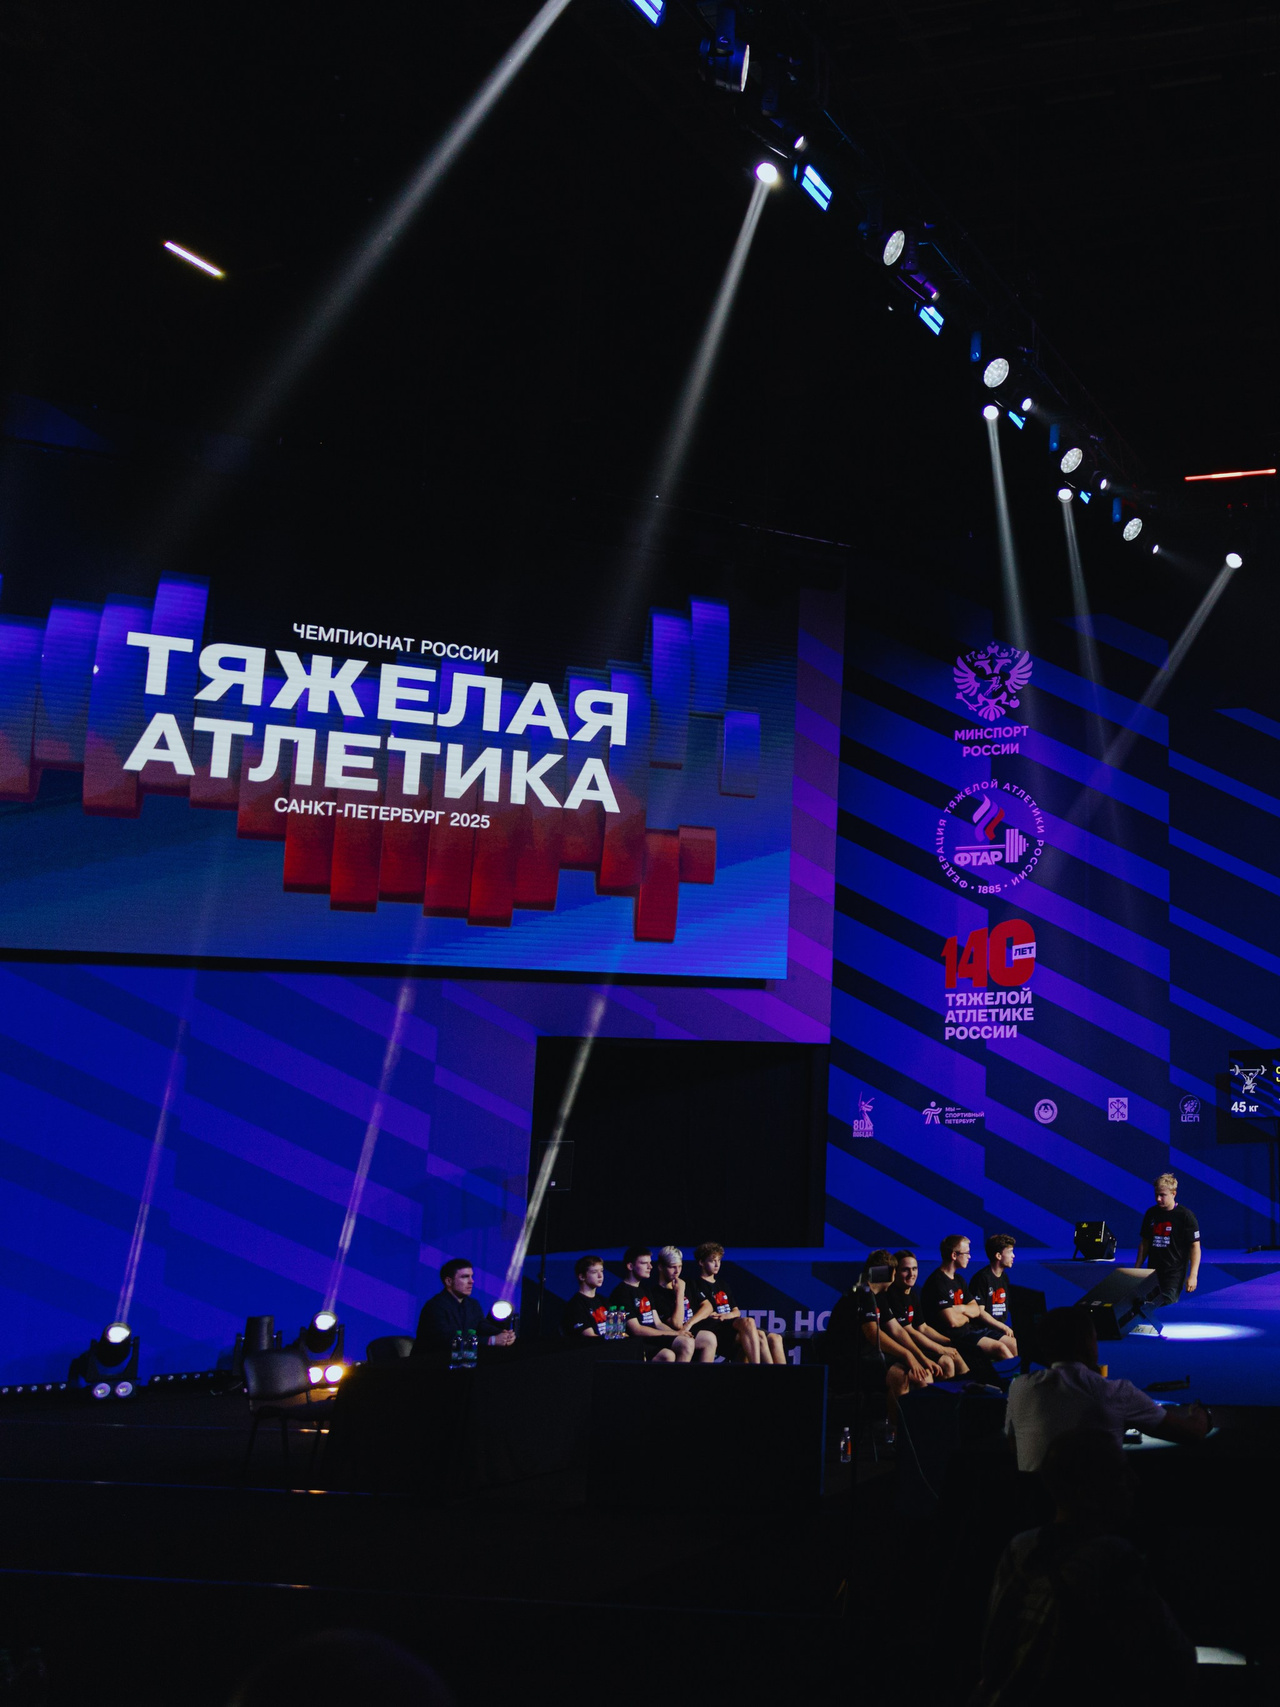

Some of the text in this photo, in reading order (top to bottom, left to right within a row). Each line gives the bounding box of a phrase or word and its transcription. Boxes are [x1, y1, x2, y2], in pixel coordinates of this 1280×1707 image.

[292, 622, 499, 664] ЧЕМПИОНАТ РОССИИ
[125, 631, 629, 747] ТЯЖЕЛАЯ
[954, 725, 1029, 741] МИНСПОРТ
[962, 743, 1020, 757] РОССИИ
[122, 712, 621, 813] АТЛЕТИКА
[273, 797, 491, 829] САНКТ-ПЕТЕРБУРГ 2025
[935, 779, 1045, 889] ФЕДЕРАЦИЯ ТЯЖЕЛОЙ АТЛЕТИКИ РОССИИ
[953, 850, 1004, 867] ФТАР
[977, 884, 1002, 895] 1885
[941, 918, 1035, 989] 140
[1013, 946, 1034, 957] ЛЕТ
[944, 987, 1033, 1007] ТЯЖЕЛОЙ
[944, 1007, 1035, 1023] АТЛЕТИКЕ
[944, 1024, 1018, 1040] РОССИИ
[1231, 1101, 1247, 1113] 45
